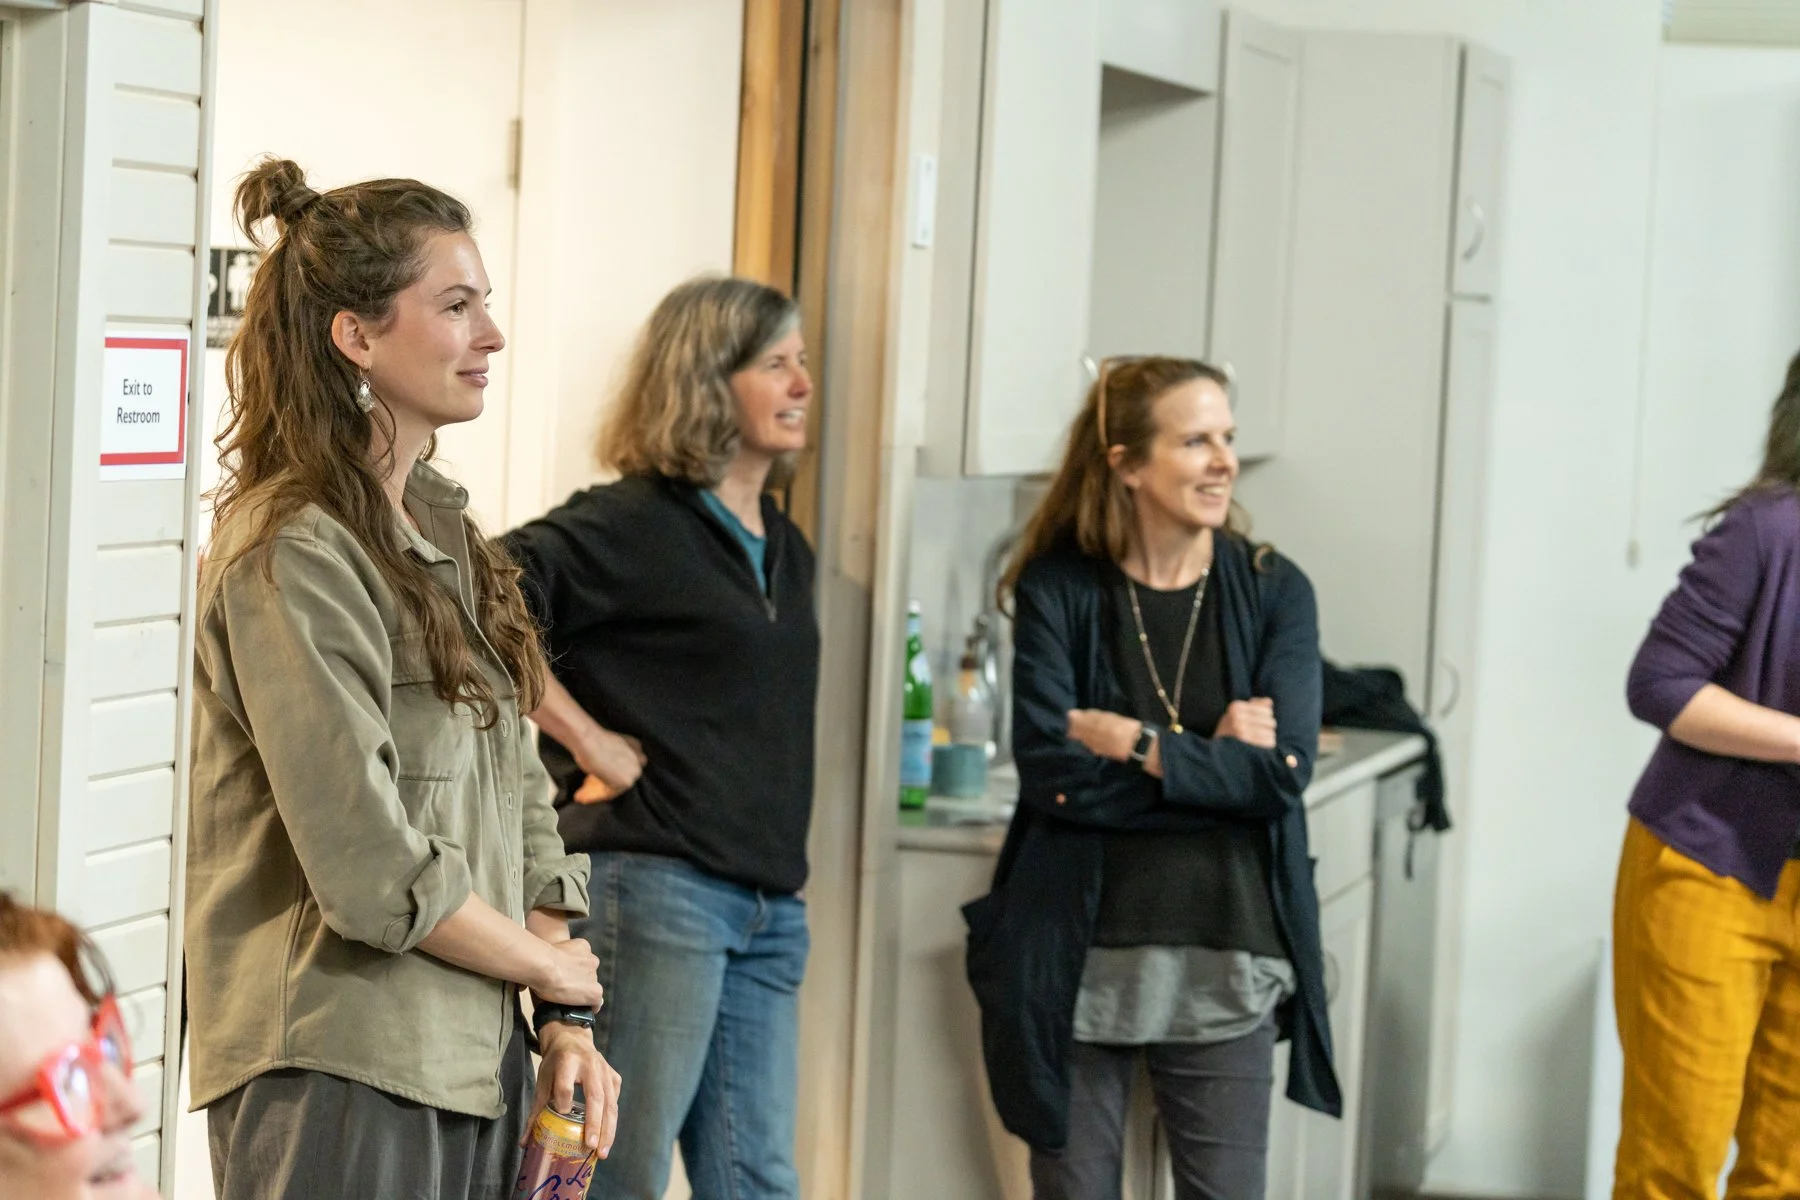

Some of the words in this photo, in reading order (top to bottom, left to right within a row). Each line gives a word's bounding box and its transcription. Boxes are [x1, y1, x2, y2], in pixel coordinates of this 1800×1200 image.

[123, 378, 140, 395] Exit
[143, 383, 153, 395] to
[117, 407, 160, 423] Restroom
